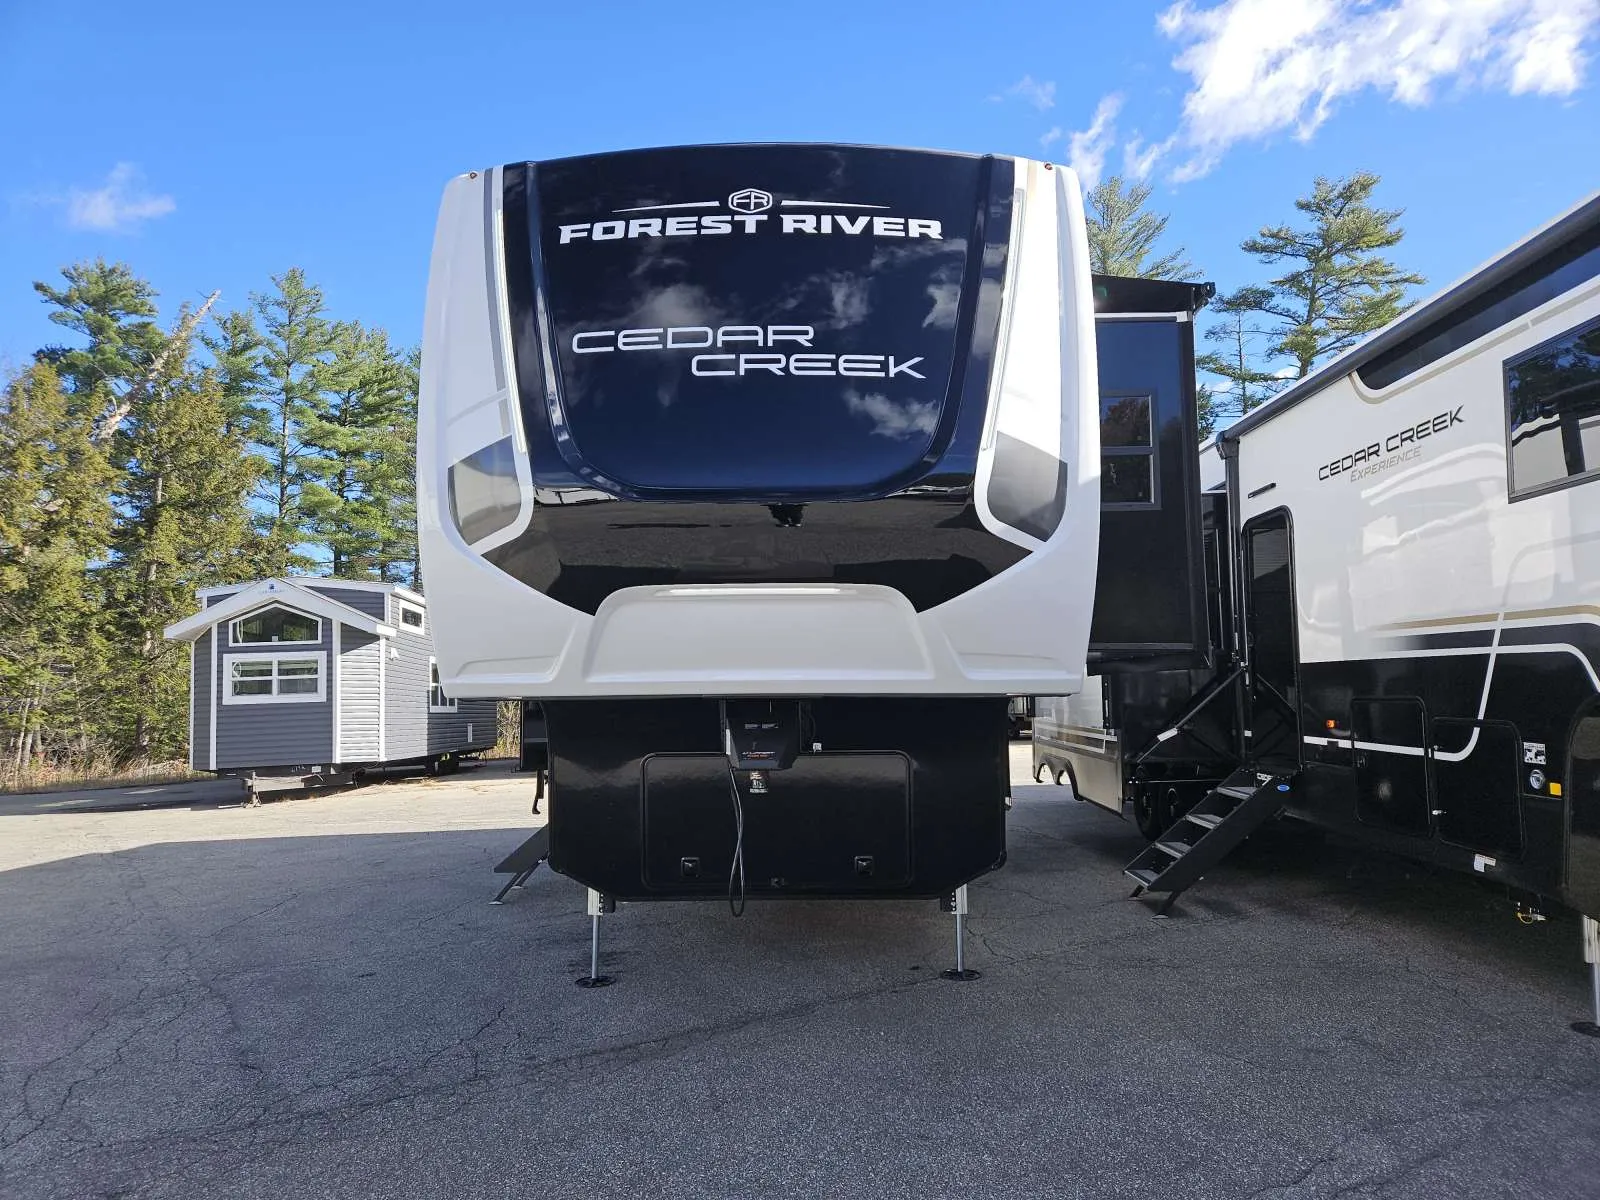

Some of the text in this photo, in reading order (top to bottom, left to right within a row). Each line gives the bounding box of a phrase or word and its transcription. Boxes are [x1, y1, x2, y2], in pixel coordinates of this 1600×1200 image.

[558, 214, 943, 244] FOREST RIVER
[572, 325, 815, 354] CEDAR
[691, 353, 927, 379] CREEK
[1318, 404, 1465, 481] CEDAR CREEK
[1350, 446, 1422, 483] EXPERIENCE
